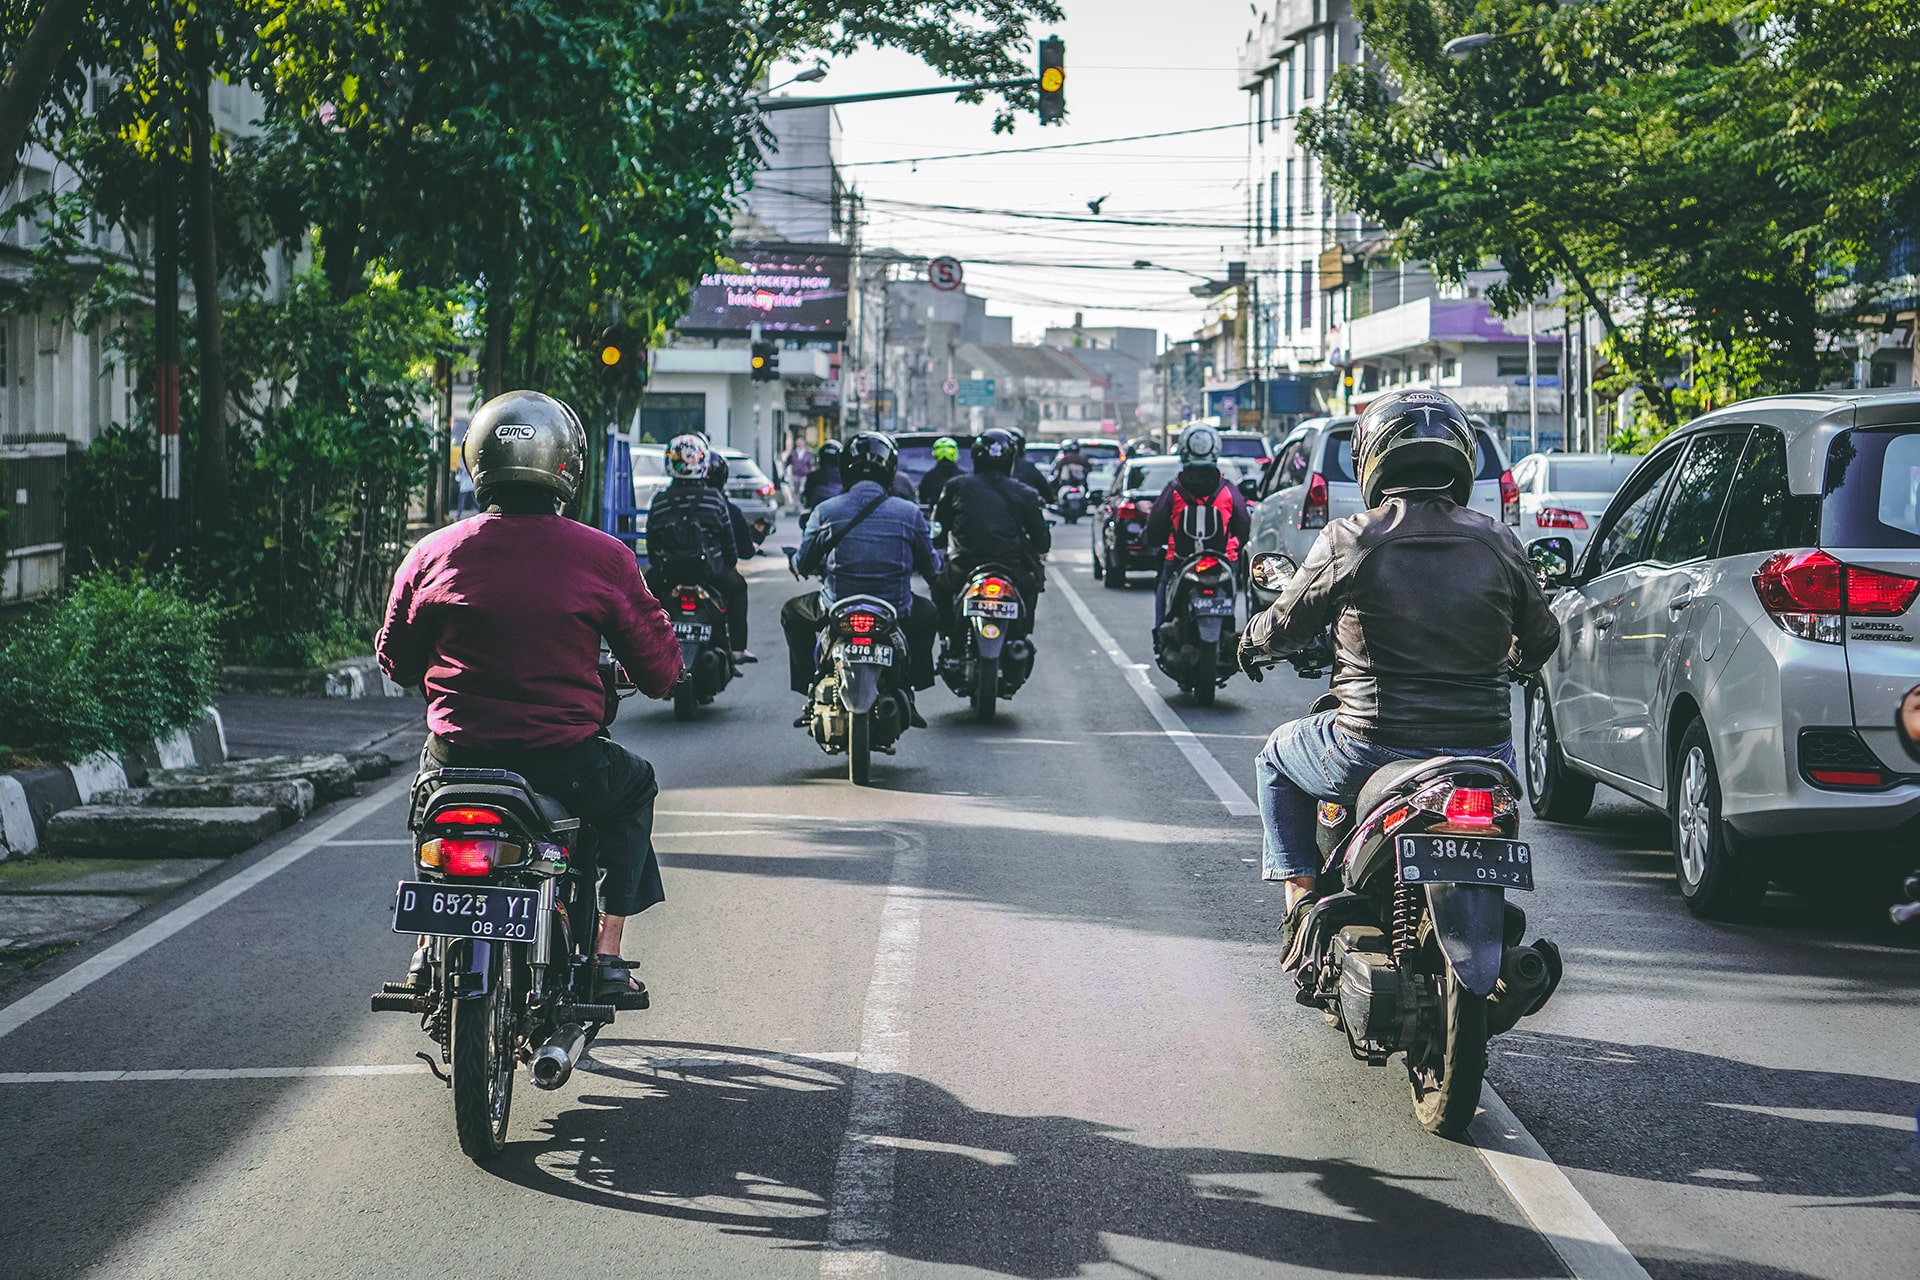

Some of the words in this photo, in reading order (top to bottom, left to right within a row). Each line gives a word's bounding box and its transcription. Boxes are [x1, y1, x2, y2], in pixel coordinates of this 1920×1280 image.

[722, 274, 754, 288] YOUR
[755, 275, 800, 289] TICKETS
[801, 277, 831, 290] NOW
[499, 427, 531, 436] BMC
[1403, 839, 1416, 858] D
[403, 891, 416, 911] D
[432, 892, 487, 916] 6525
[507, 896, 531, 918] YI
